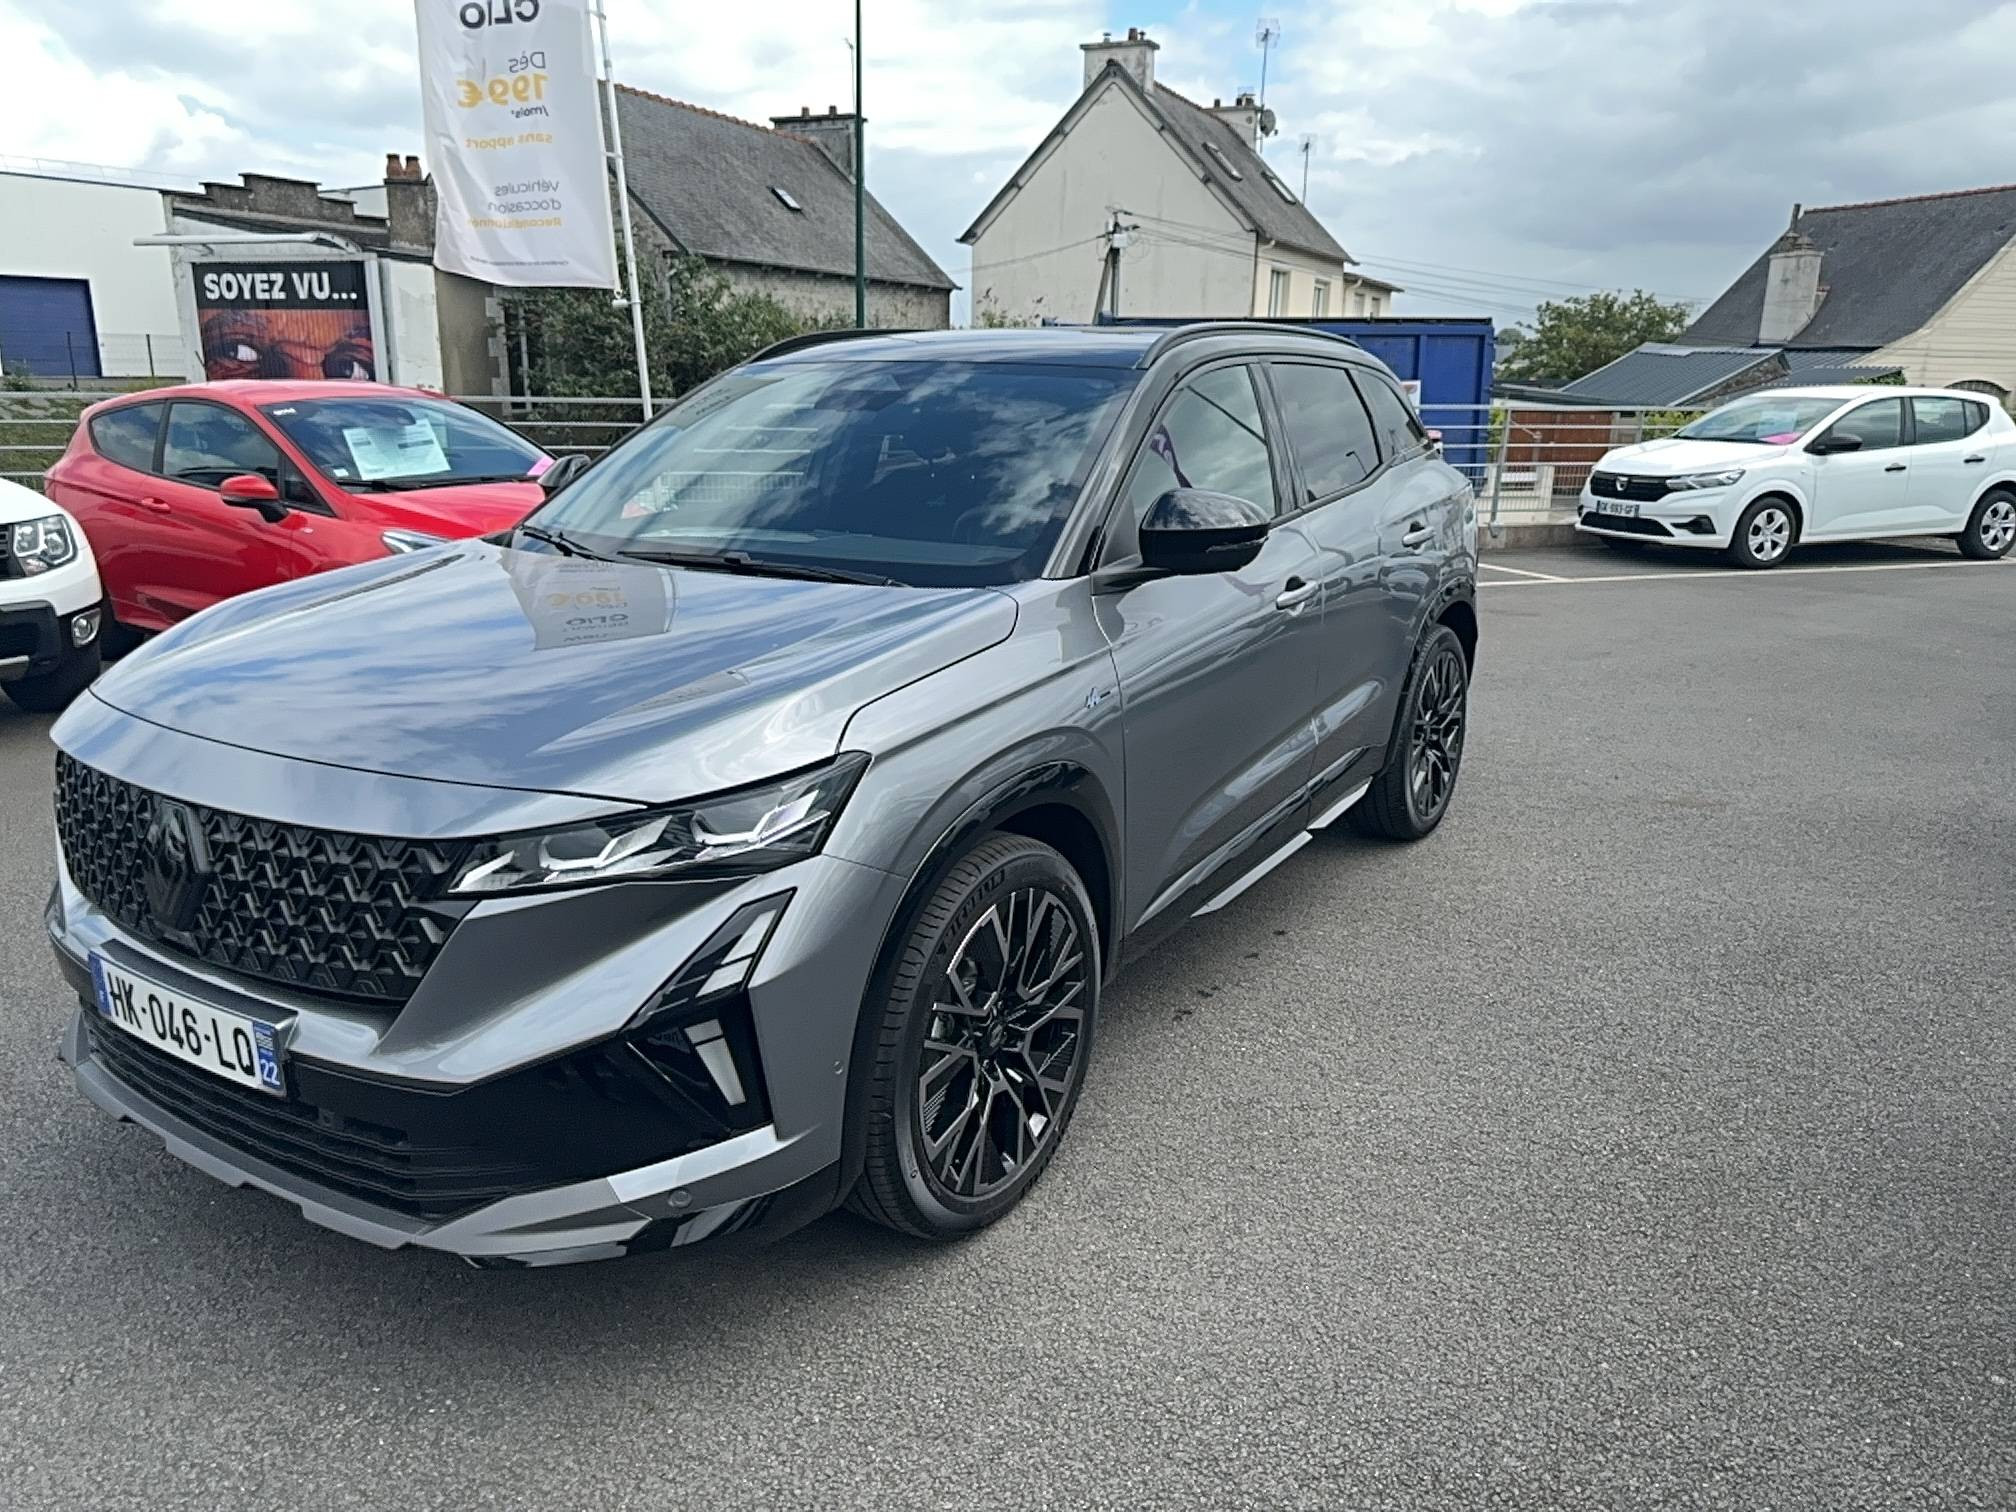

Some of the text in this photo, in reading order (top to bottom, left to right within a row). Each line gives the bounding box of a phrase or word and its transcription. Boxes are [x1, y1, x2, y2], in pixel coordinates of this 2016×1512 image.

[204, 271, 358, 300] SOYEZ VU...
[107, 972, 256, 1077] HK-046-LQ
[260, 1058, 281, 1085] 22
